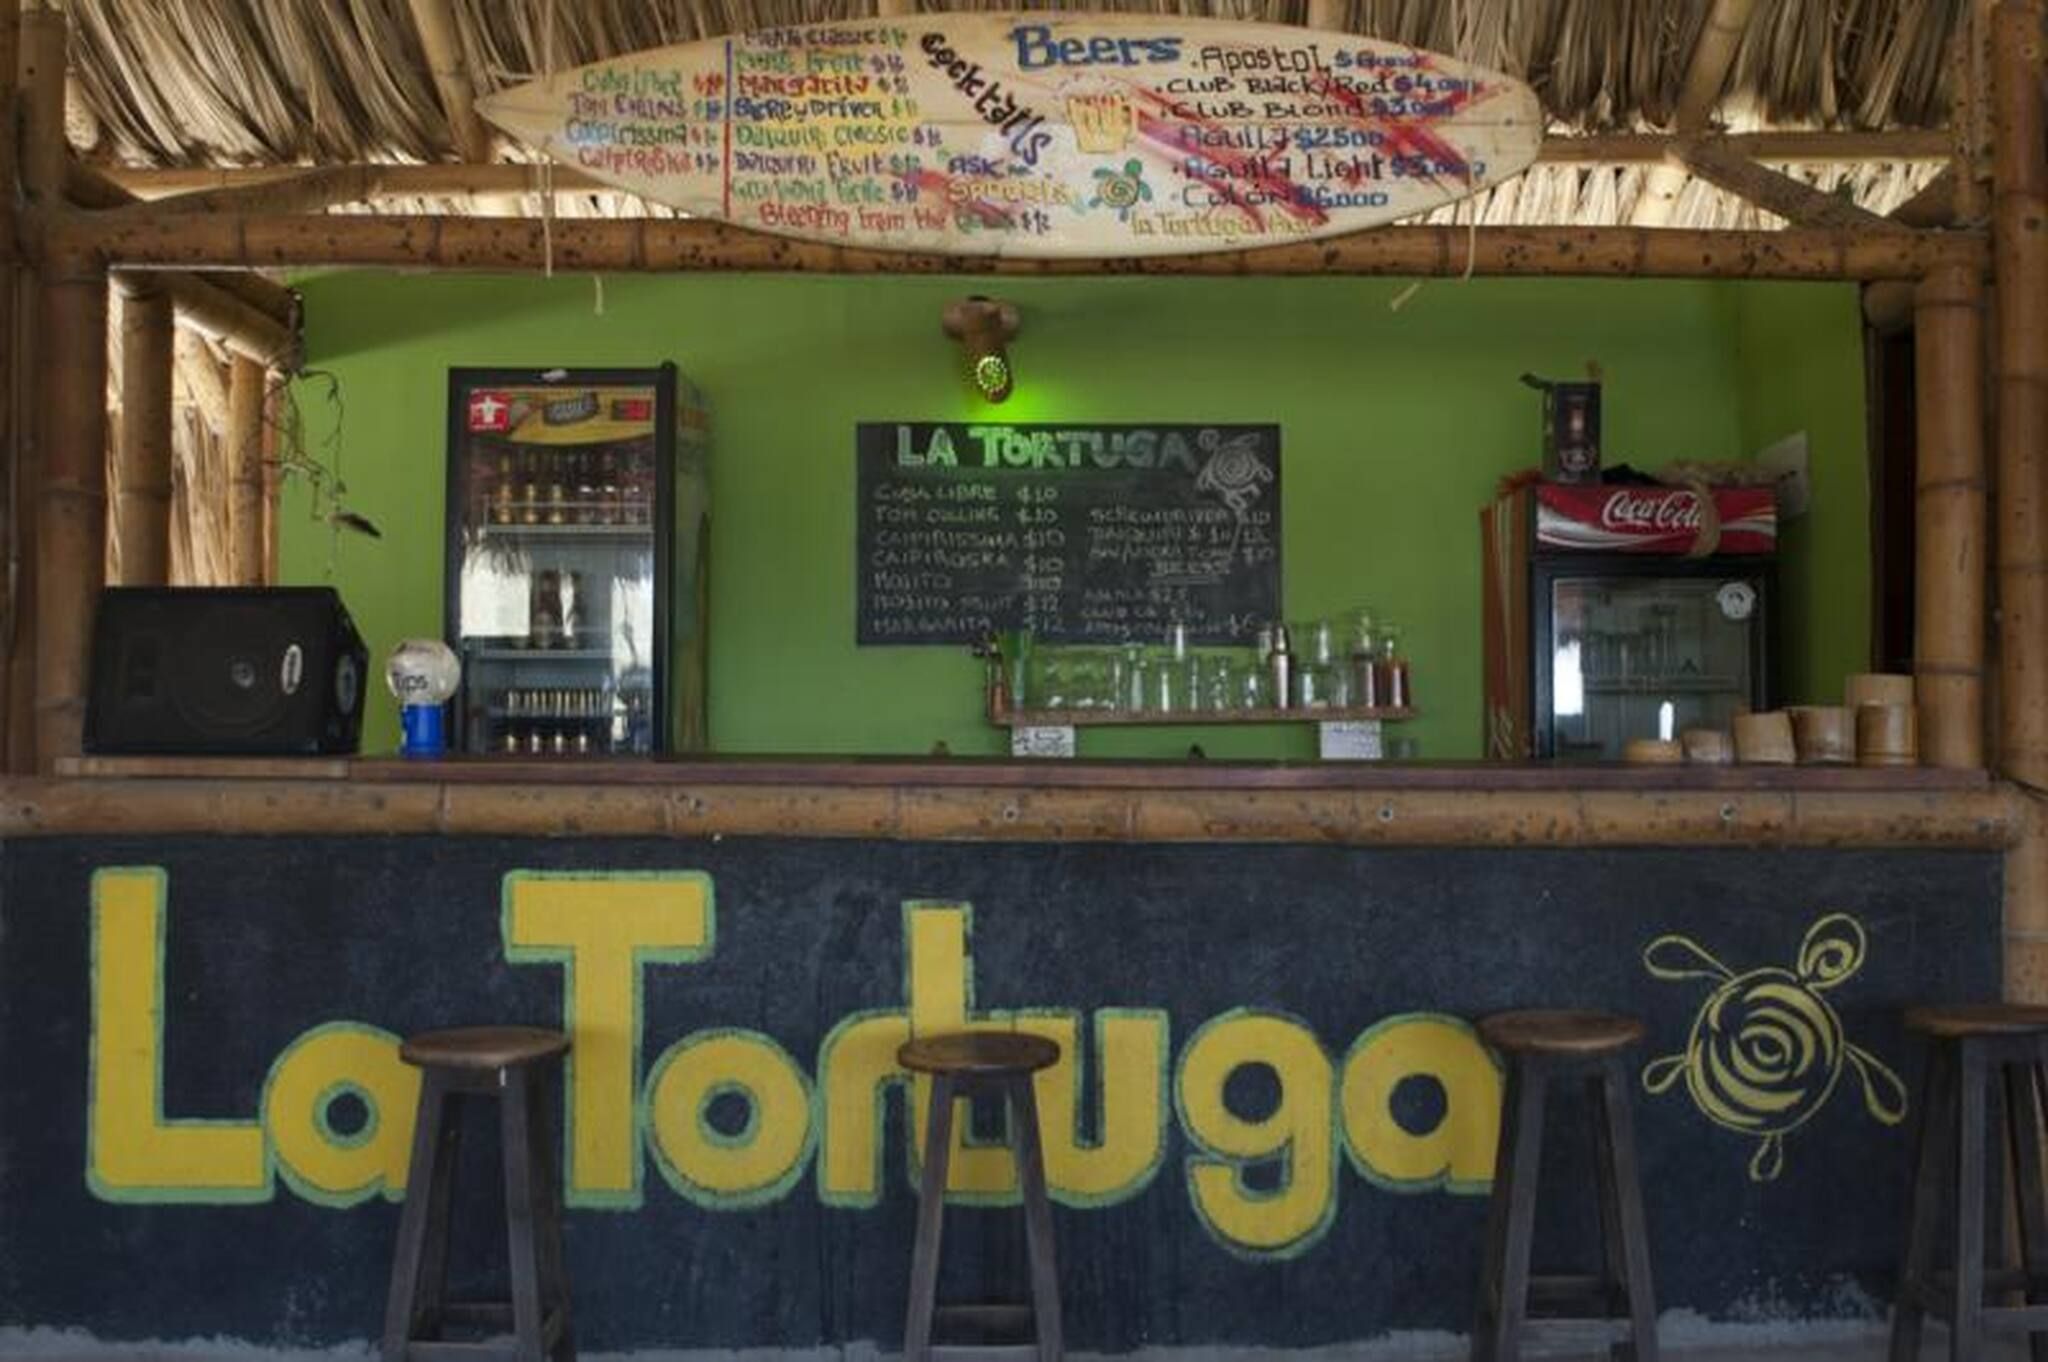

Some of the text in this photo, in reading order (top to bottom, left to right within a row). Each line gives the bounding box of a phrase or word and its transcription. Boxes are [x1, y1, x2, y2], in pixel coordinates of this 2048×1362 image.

[1008, 24, 1185, 71] Beers
[896, 425, 1200, 470] LA TORTUGA
[86, 865, 1505, 1262] La Tortuga
